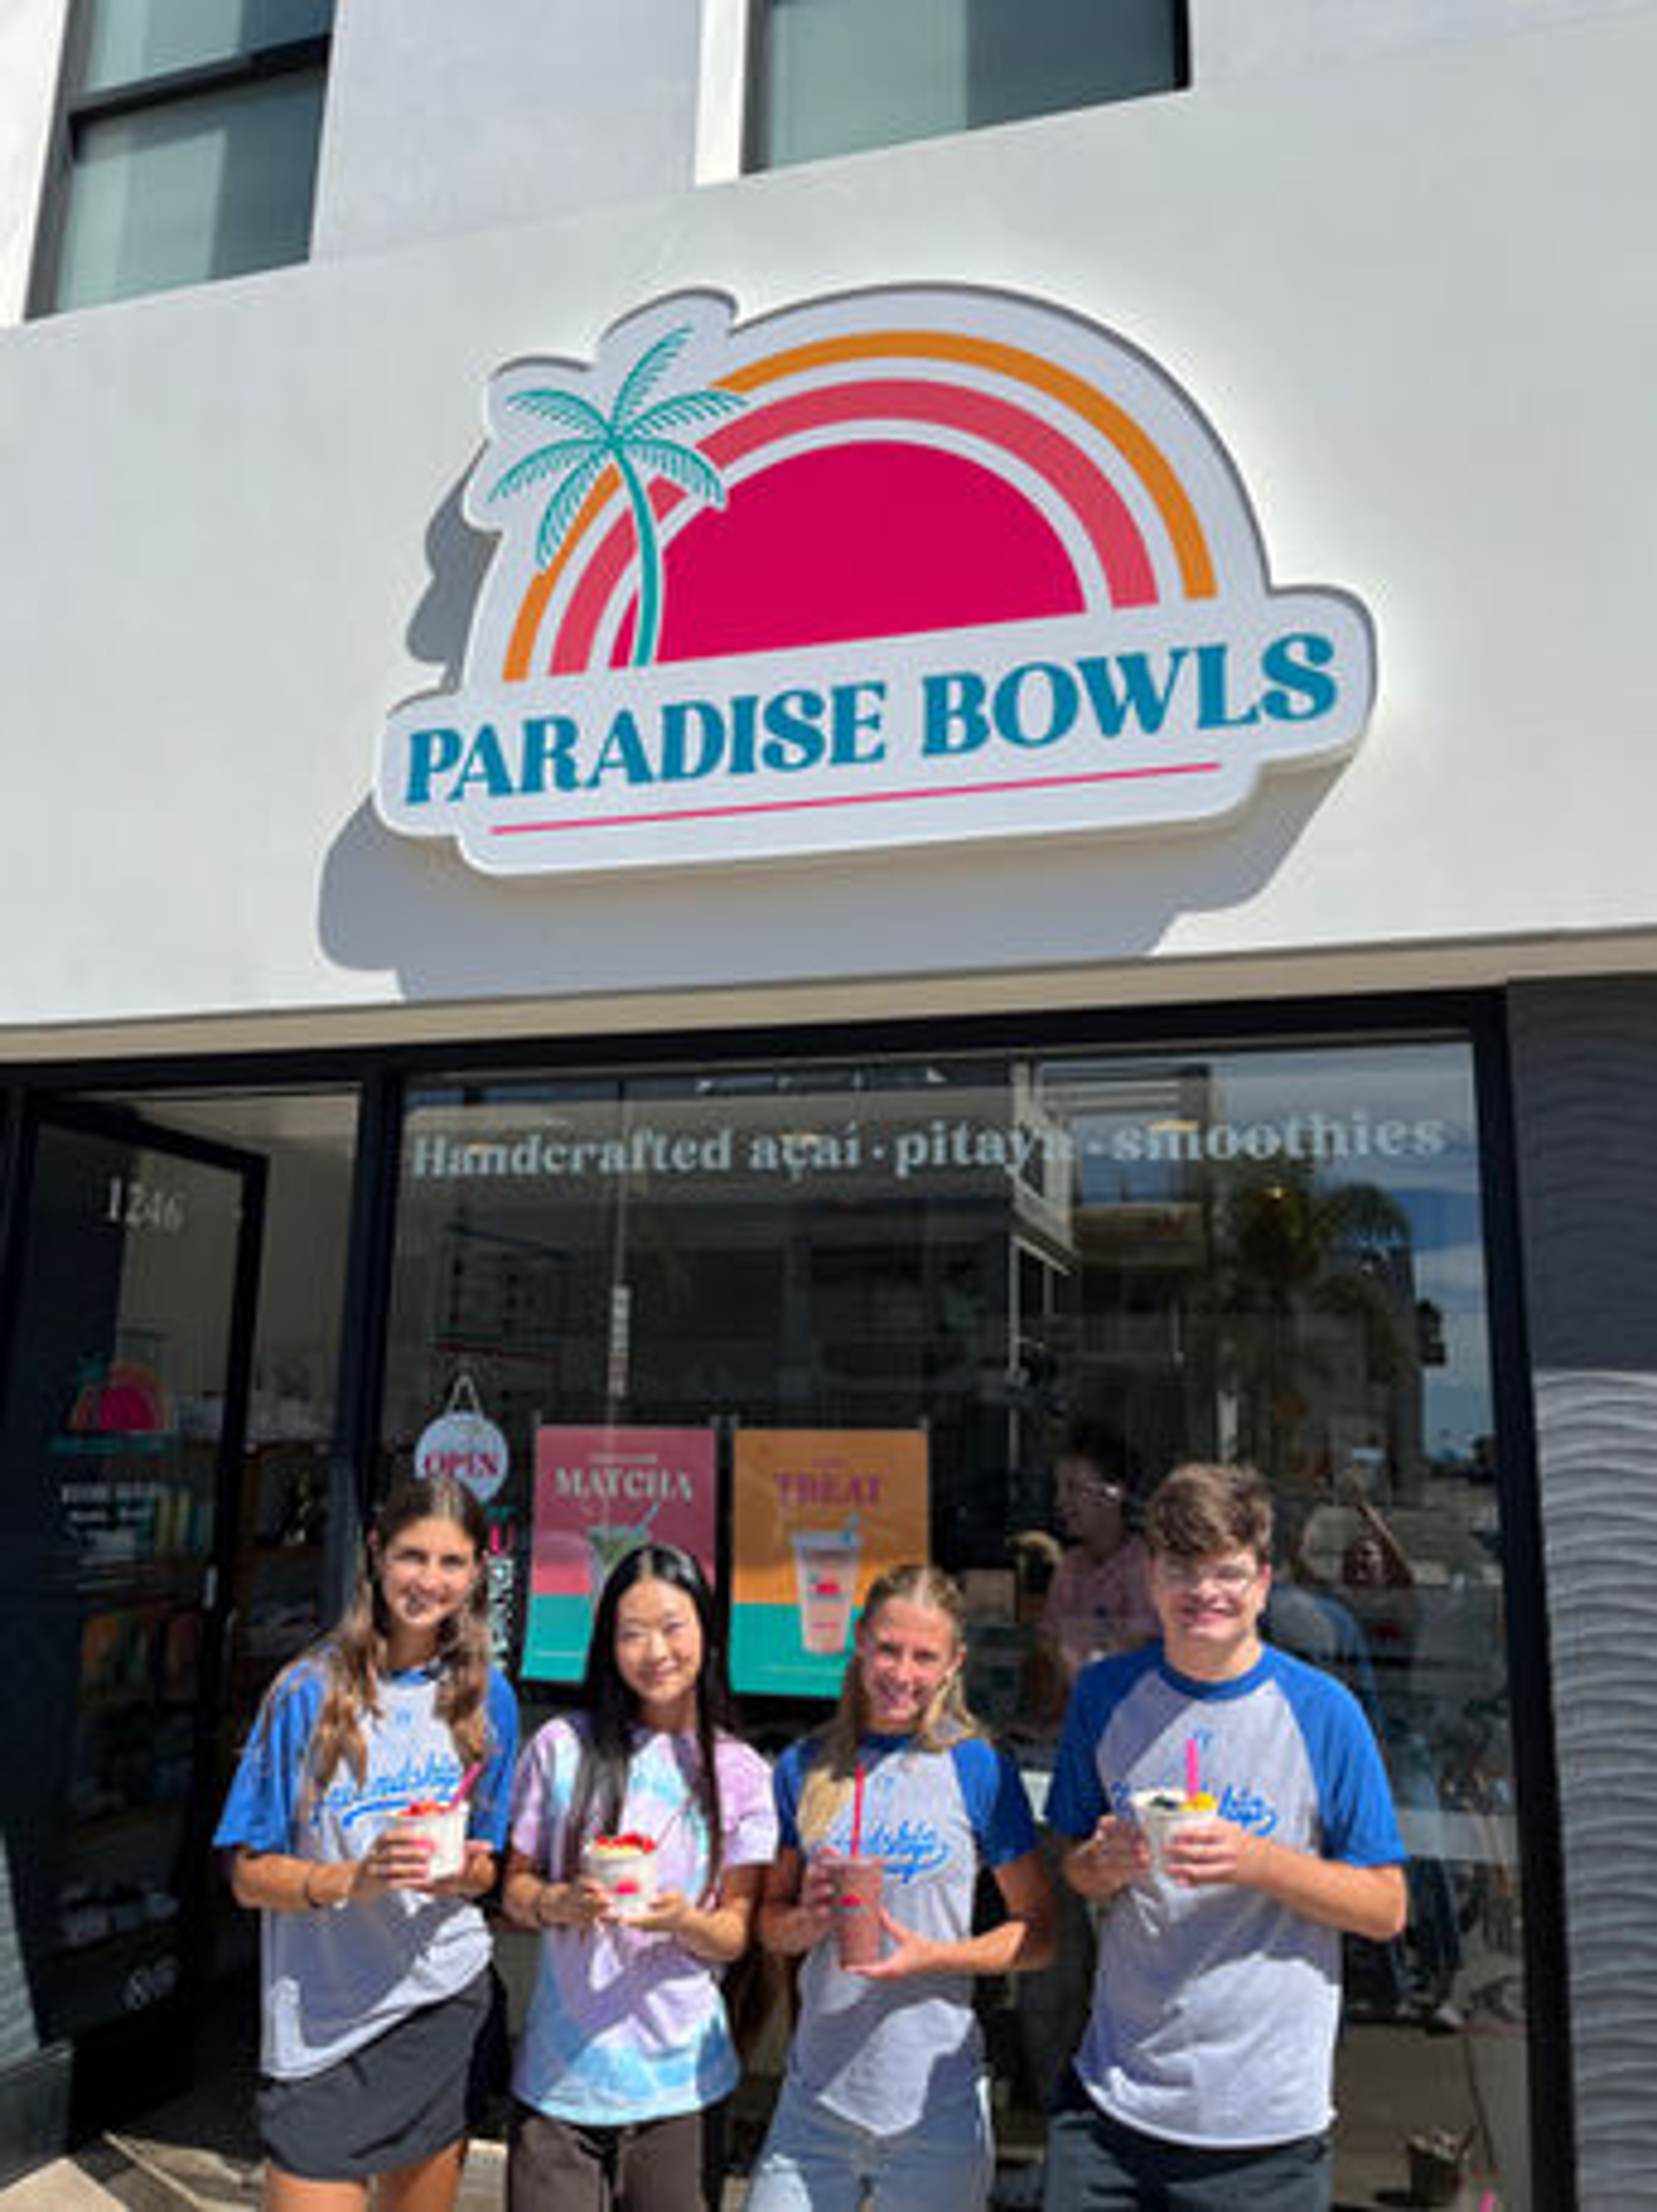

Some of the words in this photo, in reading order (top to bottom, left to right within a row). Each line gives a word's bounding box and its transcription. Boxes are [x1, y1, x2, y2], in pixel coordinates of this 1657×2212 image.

[405, 682, 887, 806] PARADISE
[922, 632, 1338, 758] BOWLS
[411, 1128, 732, 1178] Handcrafted
[1112, 1107, 1445, 1161] smoothies
[108, 1178, 186, 1232] 1246
[424, 1452, 500, 1477] OPEN
[554, 1466, 693, 1502] MATCHA
[775, 1470, 881, 1507] TREAT
